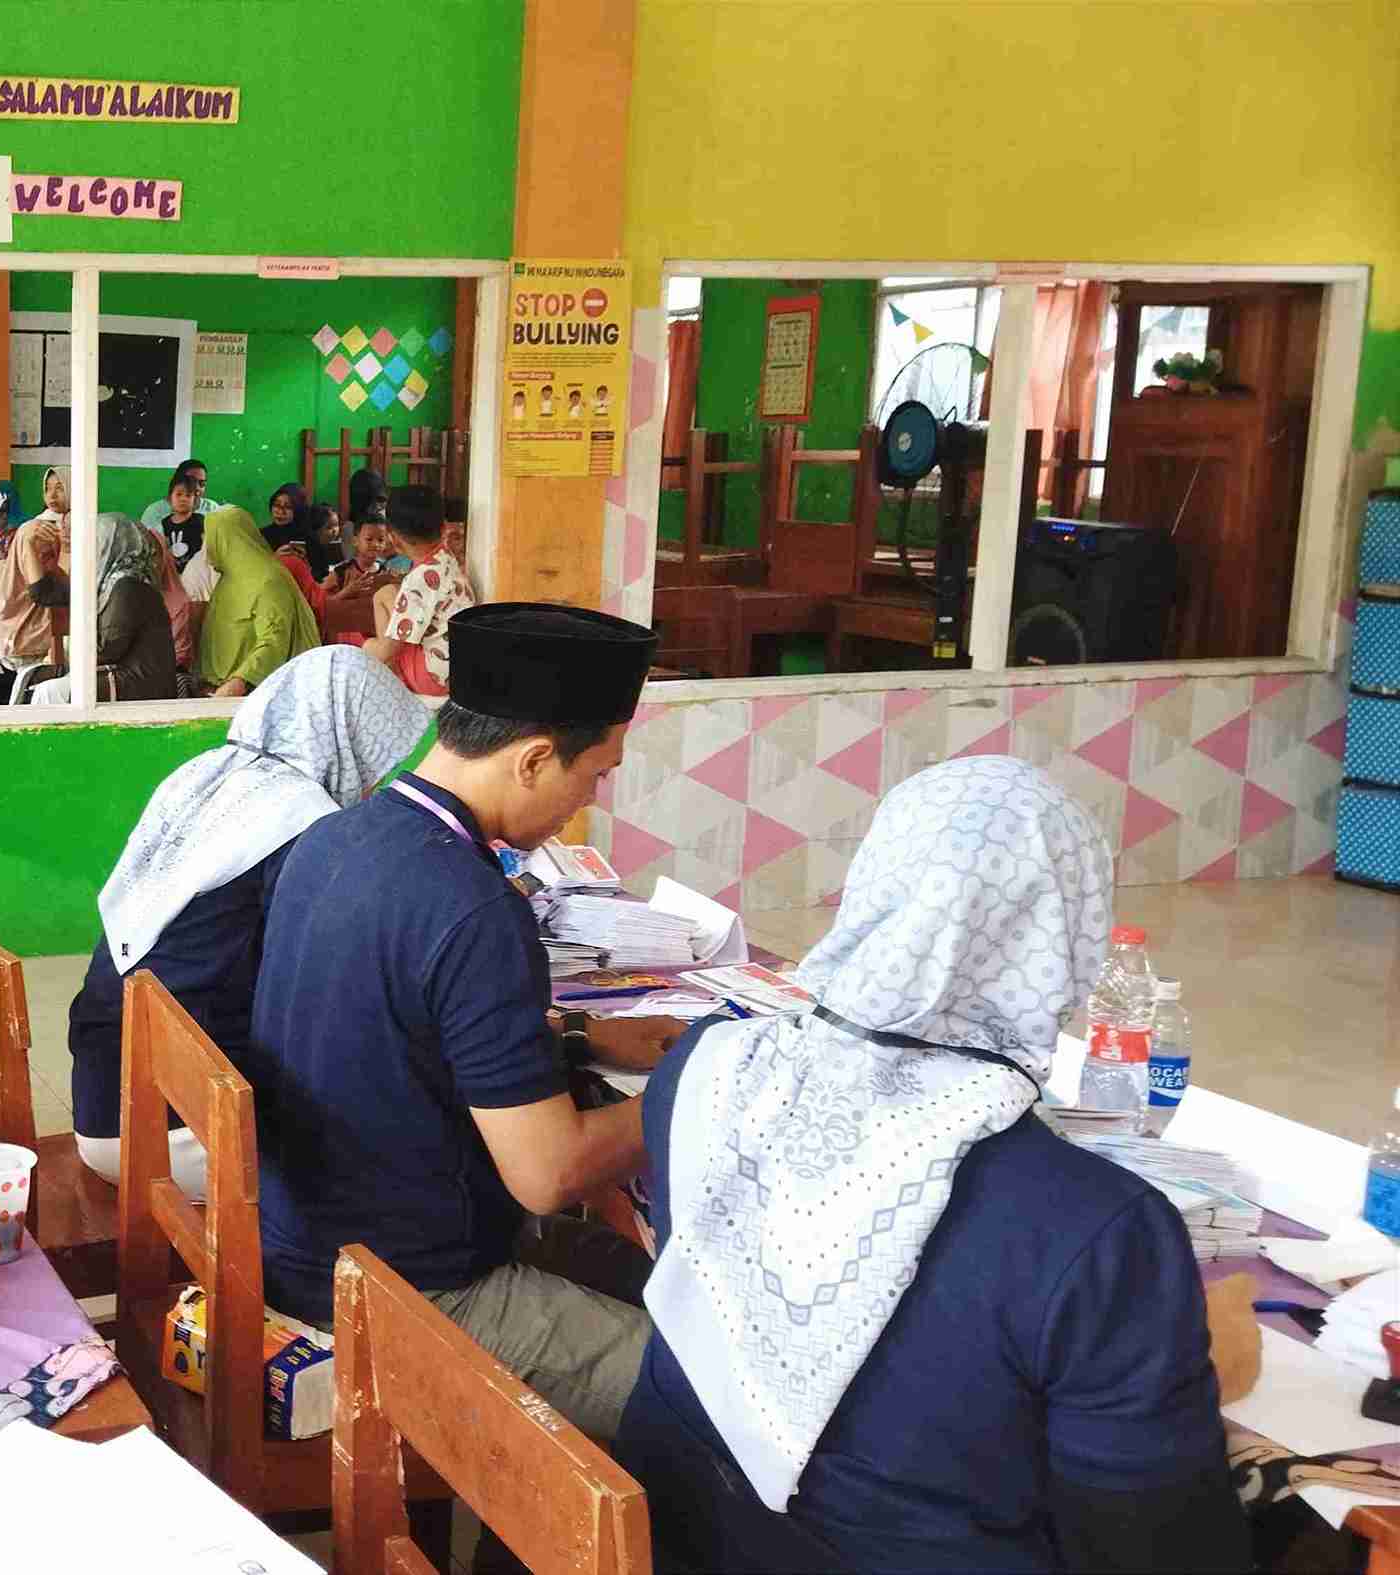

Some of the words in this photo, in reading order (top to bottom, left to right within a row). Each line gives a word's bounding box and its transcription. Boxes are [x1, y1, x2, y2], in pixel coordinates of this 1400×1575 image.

[14, 176, 177, 218] WELCOME
[515, 293, 577, 317] STOP
[512, 323, 619, 345] BULLYING
[1149, 1077, 1185, 1088] WEA
[1150, 1066, 1188, 1078] OCA
